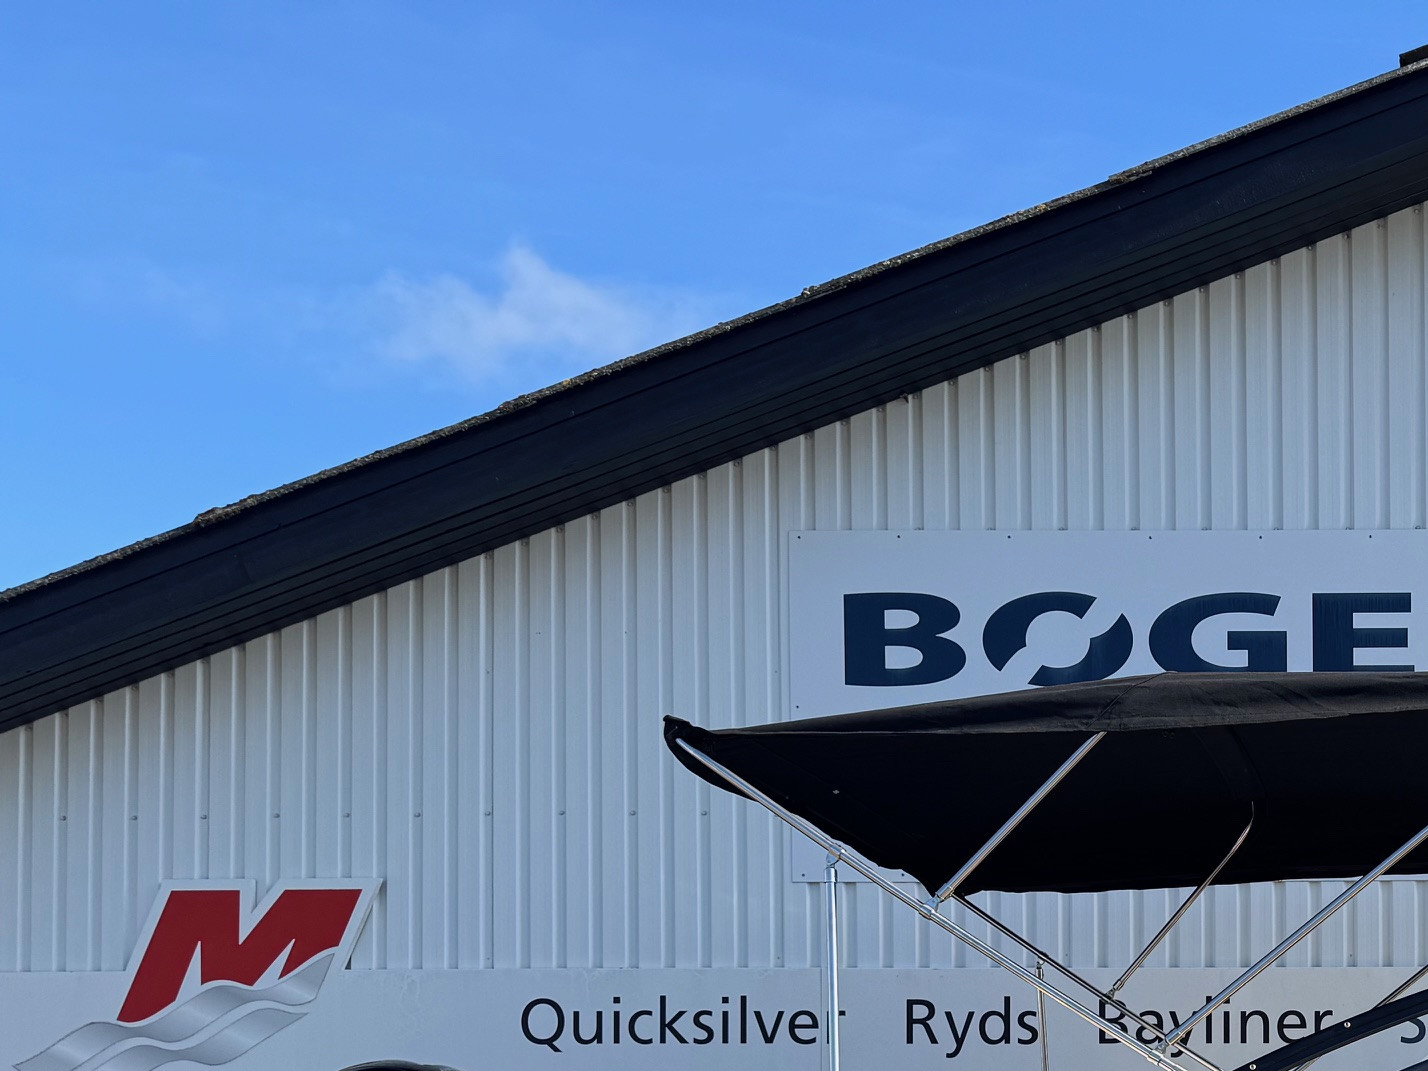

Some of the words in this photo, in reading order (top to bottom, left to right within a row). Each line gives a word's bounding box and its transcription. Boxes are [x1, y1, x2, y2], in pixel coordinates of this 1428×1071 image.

[521, 995, 846, 1053] Quicksilver
[906, 996, 1038, 1059] Ryds
[1099, 996, 1334, 1057] Bayliner
